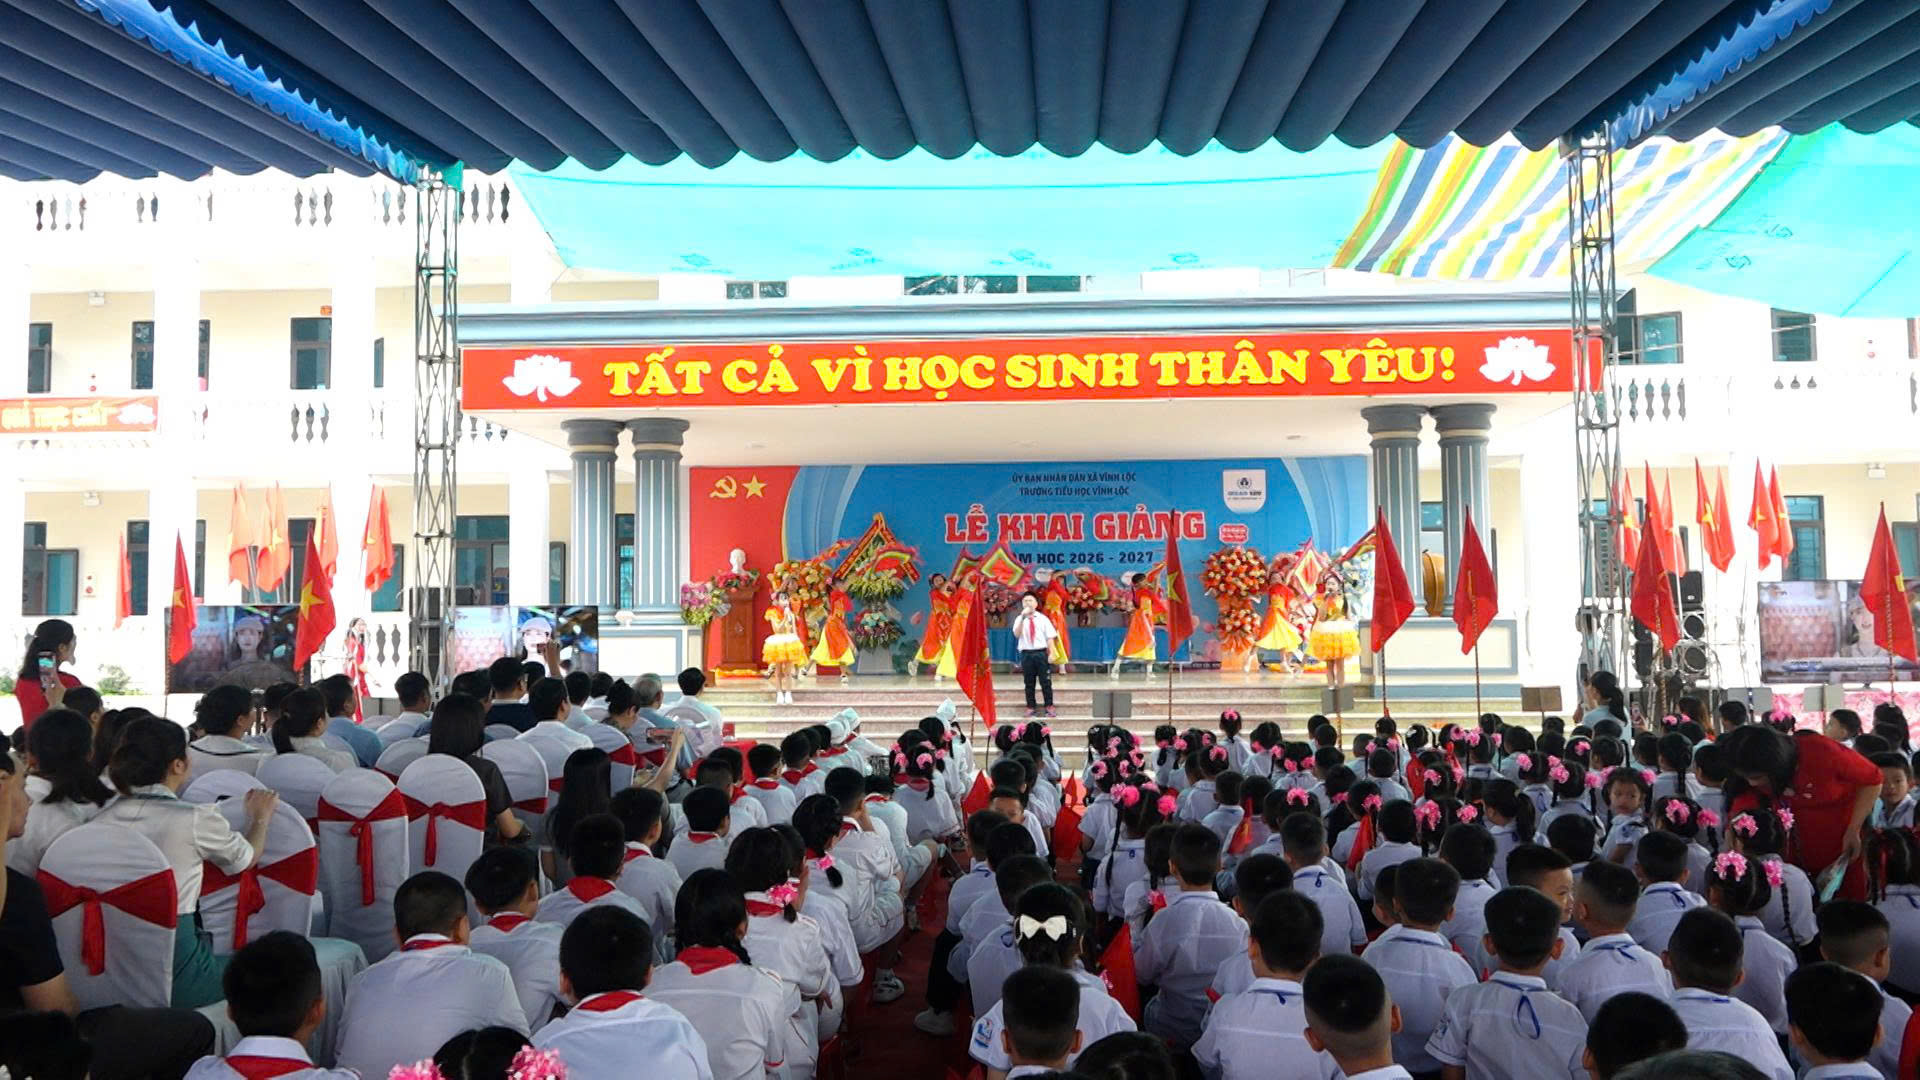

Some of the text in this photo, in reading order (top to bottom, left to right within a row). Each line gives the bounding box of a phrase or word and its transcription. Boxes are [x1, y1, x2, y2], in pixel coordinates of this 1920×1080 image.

[603, 337, 1456, 400] TẤT CẢ VÌ HỌC SINH THÂN YÊU!
[1025, 474, 1042, 483] BAN
[1044, 471, 1067, 482] NHÂN
[1069, 471, 1086, 482] DÂN
[1122, 471, 1137, 483] LỘC
[1020, 485, 1053, 497] TRƯỜNG
[1075, 487, 1091, 497] HỌC
[945, 503, 1206, 543] LỄ KHAI GIẢNG
[1069, 552, 1104, 564] 2026
[1119, 551, 1154, 563] 2027
